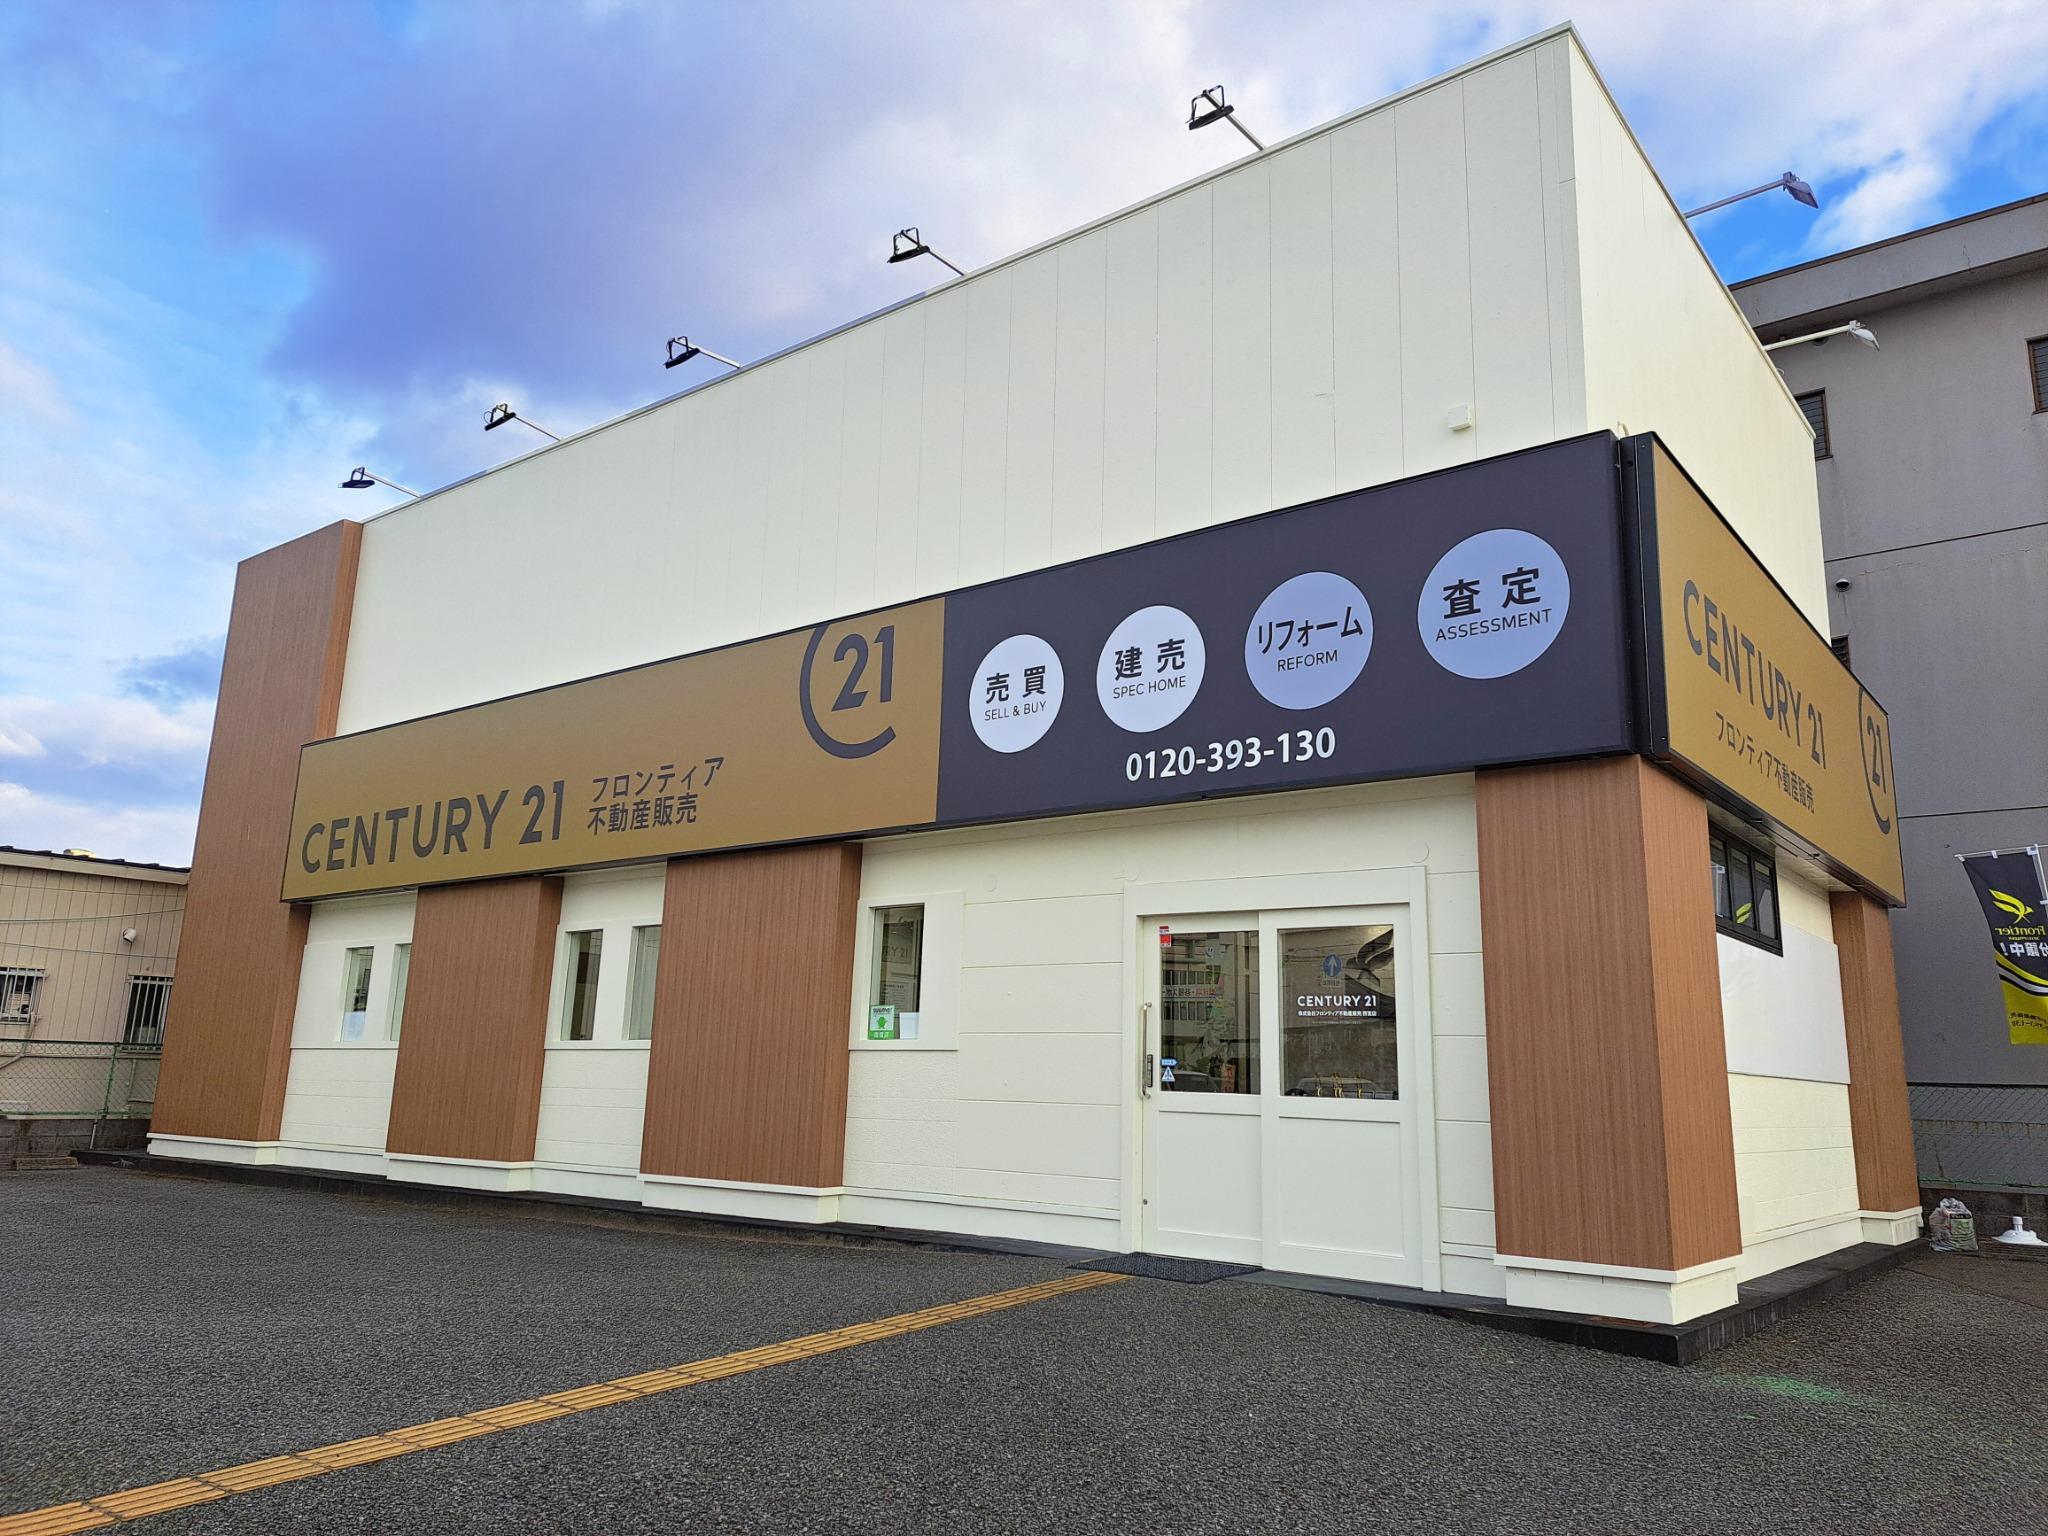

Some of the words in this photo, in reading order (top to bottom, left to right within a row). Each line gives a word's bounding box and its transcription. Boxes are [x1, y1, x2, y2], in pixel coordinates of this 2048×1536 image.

[1443, 566, 1541, 620] 査定
[1257, 606, 1364, 654] リフォーム
[1435, 608, 1552, 642] ASSESSMENT
[1114, 637, 1186, 681] 建売
[1277, 649, 1338, 672] REFORM
[1683, 580, 1802, 747] CENTURY
[1807, 703, 1827, 770] 21
[985, 665, 1047, 704] 売買
[1112, 681, 1145, 700] SPEC
[1147, 675, 1186, 694] HOME
[984, 706, 1011, 721] SELL
[1012, 705, 1021, 717] &
[1022, 700, 1047, 716] BUY
[1125, 727, 1336, 781] 0120-393-130
[1714, 711, 1815, 814] フロンティア不動産販売
[592, 757, 725, 803] フロンティア
[301, 789, 509, 874] CENTURY
[518, 780, 566, 846] 21
[586, 792, 700, 836] 不動産販売
[1297, 995, 1361, 1007] CENTURY
[1364, 995, 1377, 1007] 21
